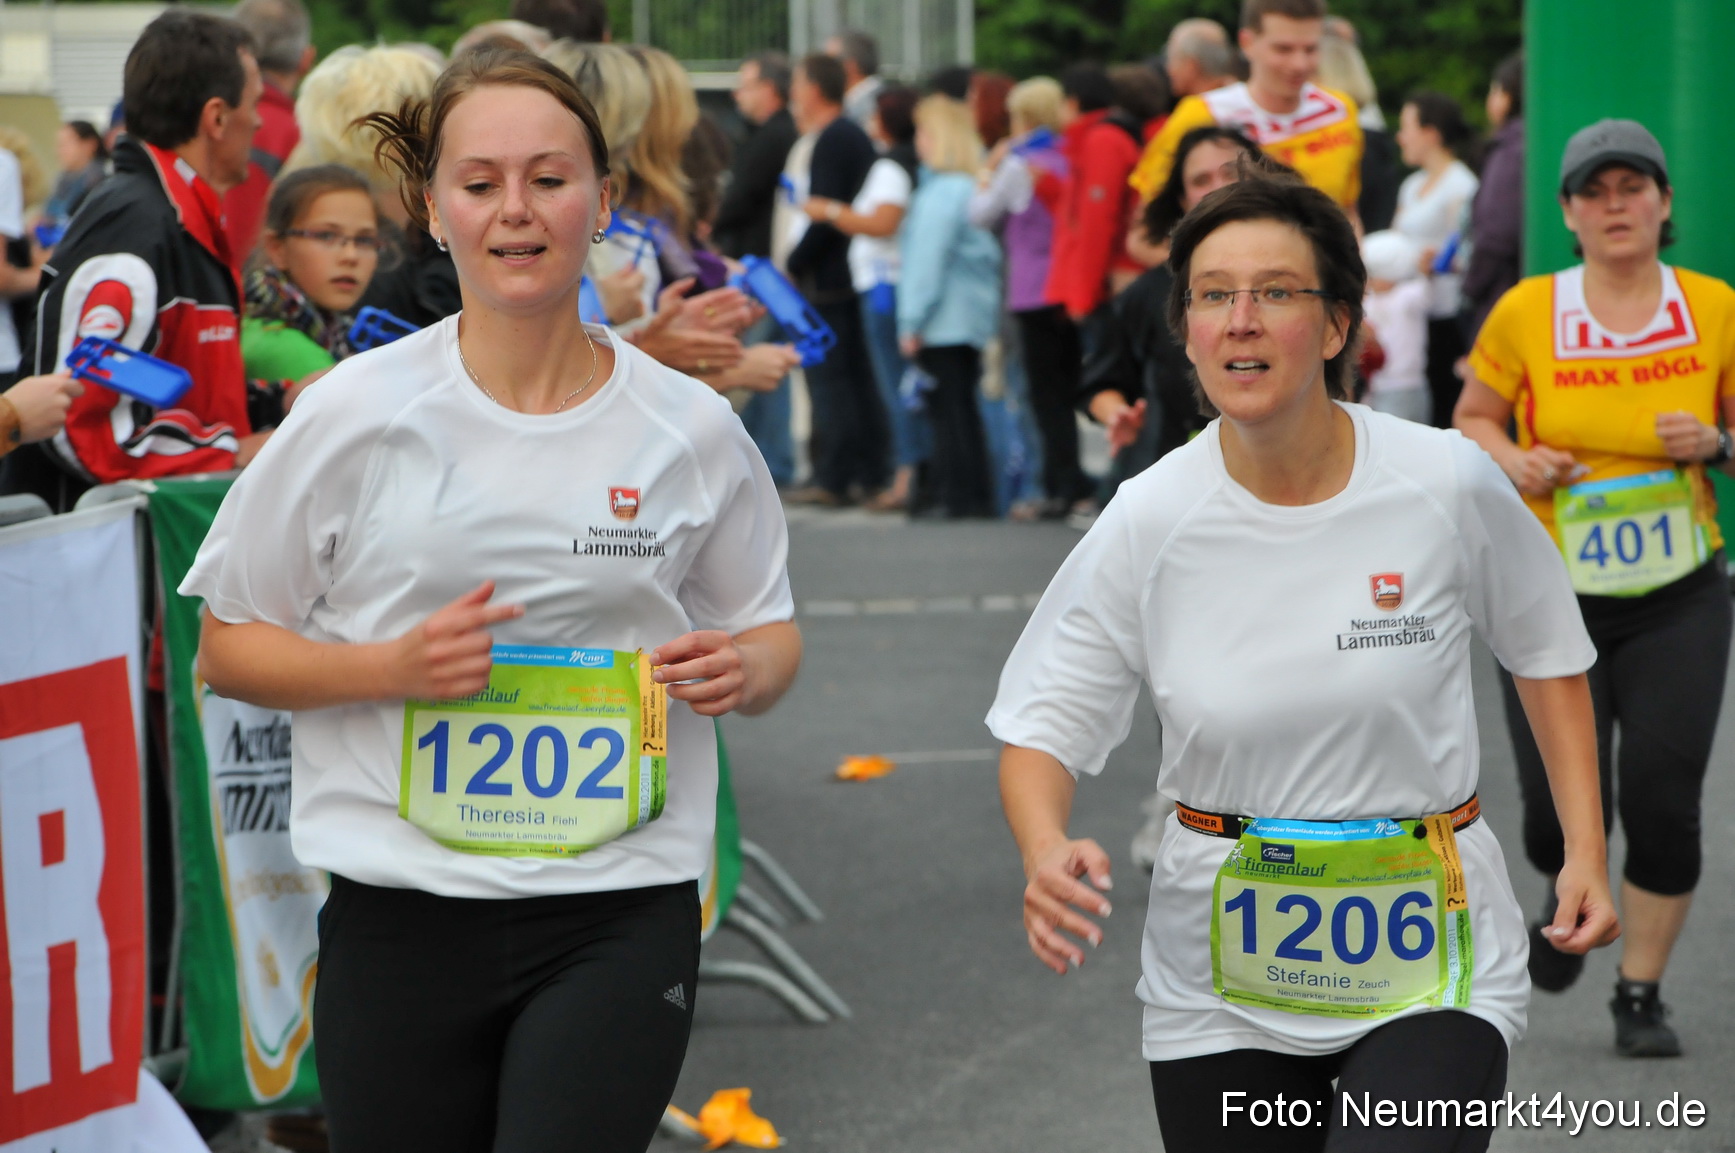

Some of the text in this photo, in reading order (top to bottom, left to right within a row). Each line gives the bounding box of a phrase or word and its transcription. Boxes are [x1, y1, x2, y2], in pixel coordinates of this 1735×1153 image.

[1554, 354, 1706, 387] MAX BÖGL
[588, 526, 657, 540] Neumarkter
[1578, 513, 1673, 568] 401
[573, 539, 665, 557] Lammsbräu
[1351, 615, 1426, 632] Neumarkter
[1336, 627, 1436, 651] Lammsbräu
[418, 720, 625, 800] 1202
[456, 803, 578, 826] Theresia Fiehl
[1181, 811, 1217, 829] WAGNER
[465, 829, 567, 841] Neumarkter Lammsbräu
[1257, 824, 1285, 833] oberpfälzer
[1285, 826, 1314, 835] firmenläufe
[1315, 828, 1333, 836] werden
[1265, 848, 1293, 858] Fischer
[1244, 857, 1328, 877] firmenlauf
[1245, 871, 1280, 879] neumarkt
[1225, 887, 1435, 965] 1206
[1447, 928, 1458, 967] 3.10.2011
[1266, 965, 1390, 989] Stefanie Zeuch
[1277, 988, 1380, 1004] Neumarkter Lammsbräu
